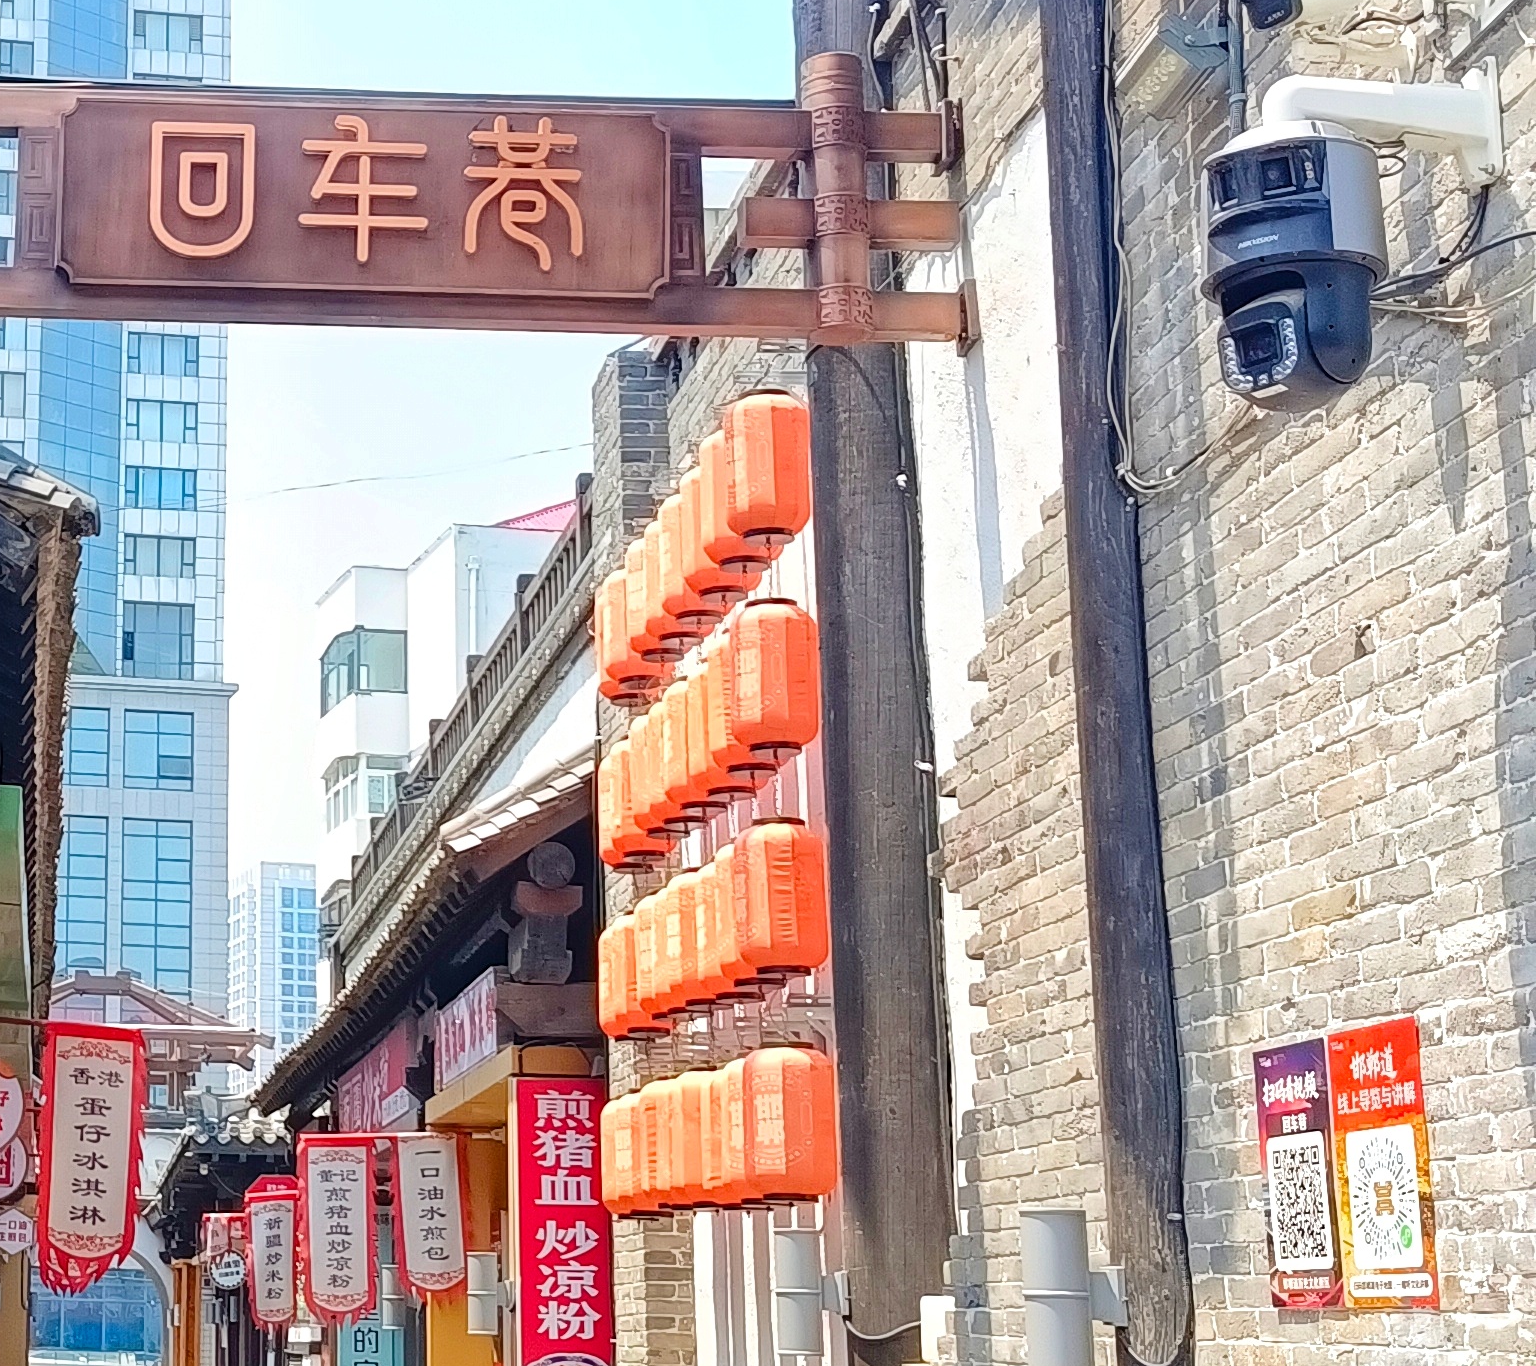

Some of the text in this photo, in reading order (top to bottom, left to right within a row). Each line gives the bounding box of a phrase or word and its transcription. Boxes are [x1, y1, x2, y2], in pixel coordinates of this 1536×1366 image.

[149, 115, 582, 272] 回车巷
[69, 1066, 126, 1090] 香港
[1338, 1080, 1416, 1115] 线上导览与讲解
[69, 1096, 114, 1226] 蛋仔冰淇淋
[414, 1148, 451, 1262] 一口油水煎包
[263, 1216, 285, 1300] 新疆炒米粉
[324, 1187, 354, 1290] 煎猪血炒凉粉
[532, 1091, 602, 1341] 煎猪血 炒凉粉
